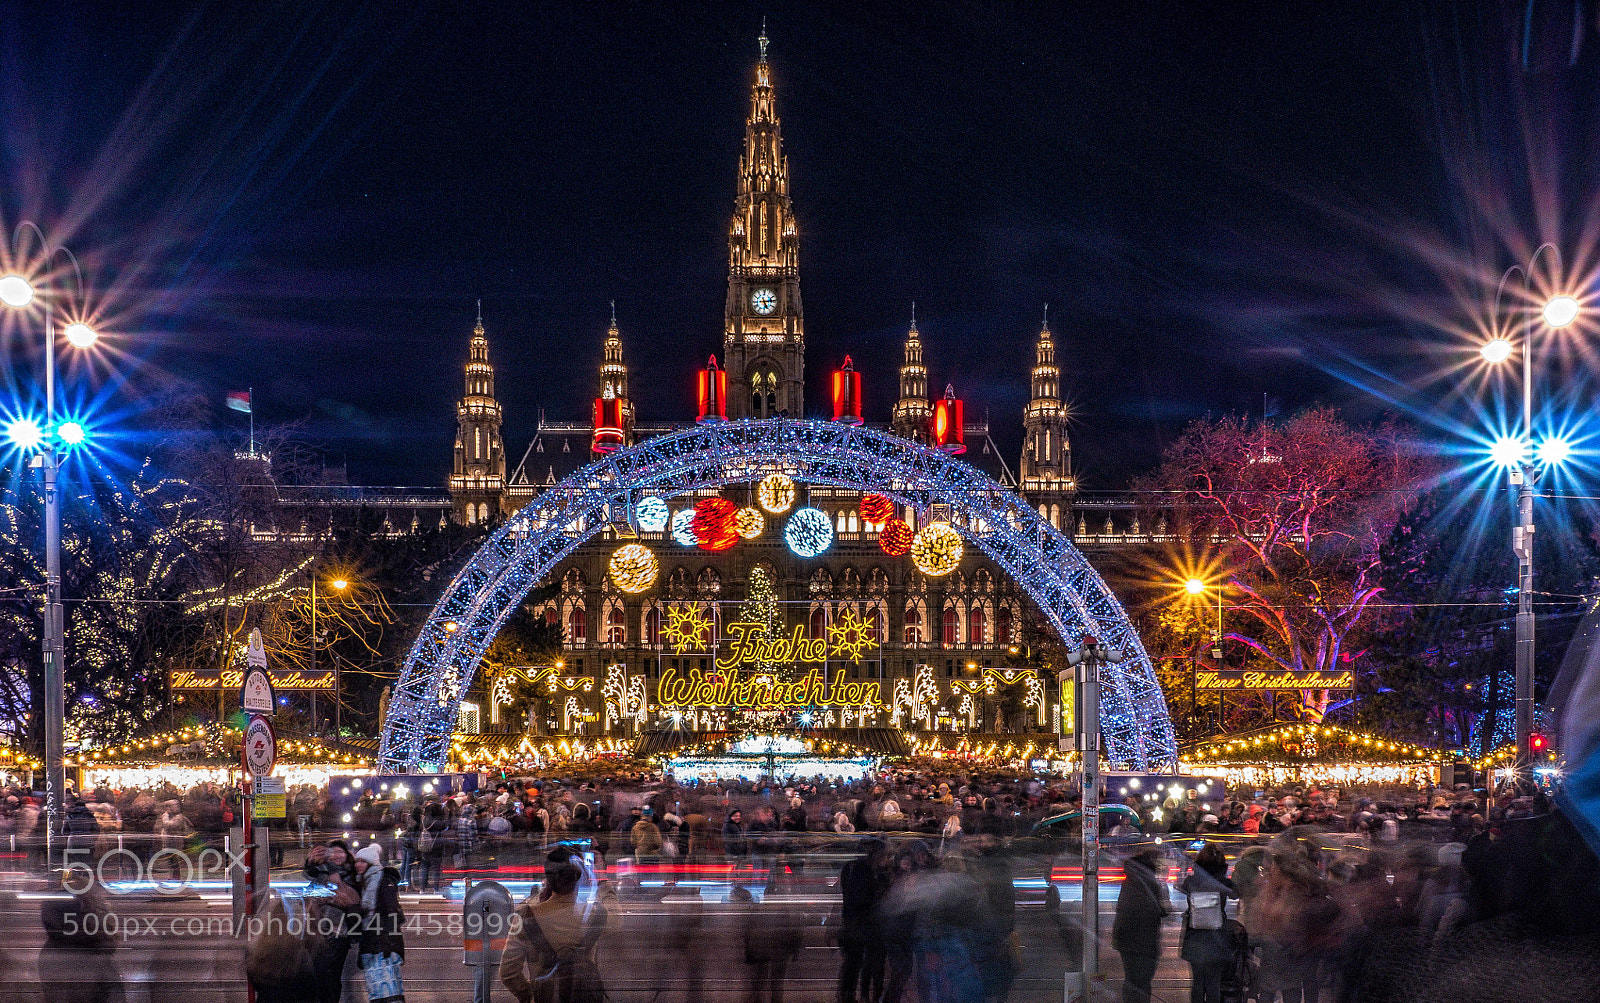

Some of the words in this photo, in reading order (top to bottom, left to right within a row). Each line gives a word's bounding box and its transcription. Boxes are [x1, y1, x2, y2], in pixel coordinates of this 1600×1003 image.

[715, 622, 827, 669] Frohe
[171, 671, 219, 688] Wiener
[658, 668, 882, 707] Weihnachten
[1196, 671, 1242, 688] Wiener
[1243, 671, 1353, 689] Christkindlmarkt
[245, 697, 271, 708] HALTESTELLE
[248, 755, 272, 775] HALTESTELLE
